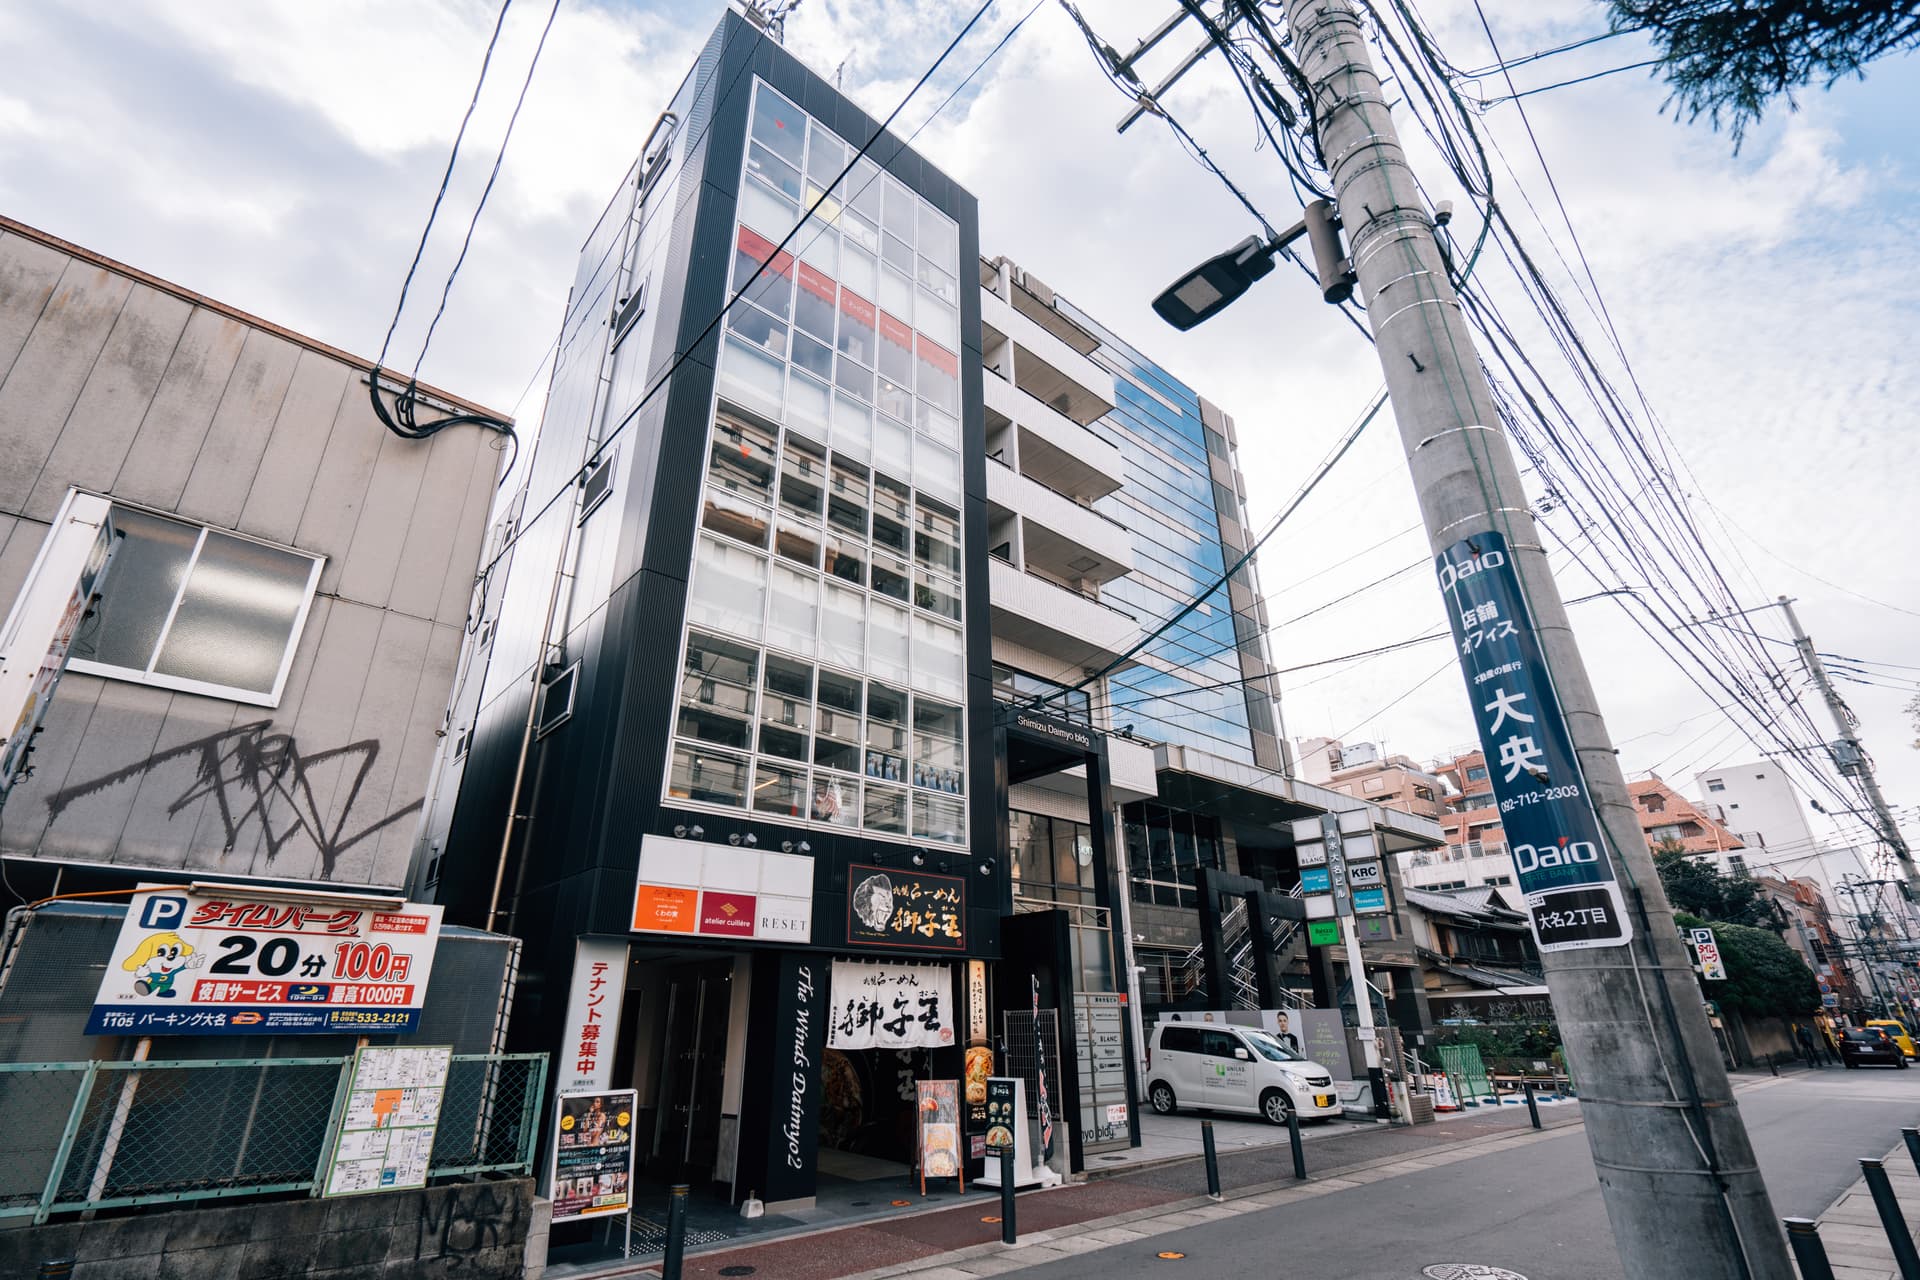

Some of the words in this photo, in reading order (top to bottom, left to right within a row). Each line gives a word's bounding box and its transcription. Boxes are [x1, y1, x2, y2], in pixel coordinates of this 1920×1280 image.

[1440, 551, 1504, 593] Daio
[1462, 600, 1499, 630] 店舗
[1461, 619, 1519, 655] オフィス
[1474, 660, 1522, 685] 不動産の銀行
[1017, 715, 1047, 732] Shimizu
[1047, 724, 1074, 741] Daimyo
[1074, 732, 1090, 747] bldg
[1484, 687, 1548, 783] 大央
[1500, 784, 1580, 814] 092-712-2303
[1301, 856, 1325, 865] BLANC
[1326, 829, 1346, 898] 清水大名ビル
[1352, 866, 1377, 878] KRC
[1513, 839, 1599, 875] Daio
[149, 900, 182, 927] P
[191, 901, 363, 933] タイムパーク
[704, 916, 726, 927] atelier
[727, 919, 751, 928] cuillère
[761, 917, 808, 932] RESET
[891, 907, 962, 938] 獅子王
[1538, 907, 1608, 930] 大名2丁目
[1695, 931, 1709, 943] P
[209, 935, 327, 977] 20分
[332, 941, 412, 982] 100円
[198, 982, 282, 1002] 夜間サービス
[330, 985, 405, 1005] 最高1000円
[798, 965, 814, 1003] The
[102, 1016, 134, 1027] 1105
[138, 1012, 227, 1027] パーキング大名
[576, 962, 608, 1076] テナント募集中
[837, 998, 941, 1037] 獅子王
[794, 1008, 810, 1068] Winds
[1099, 1035, 1118, 1043] BLANC
